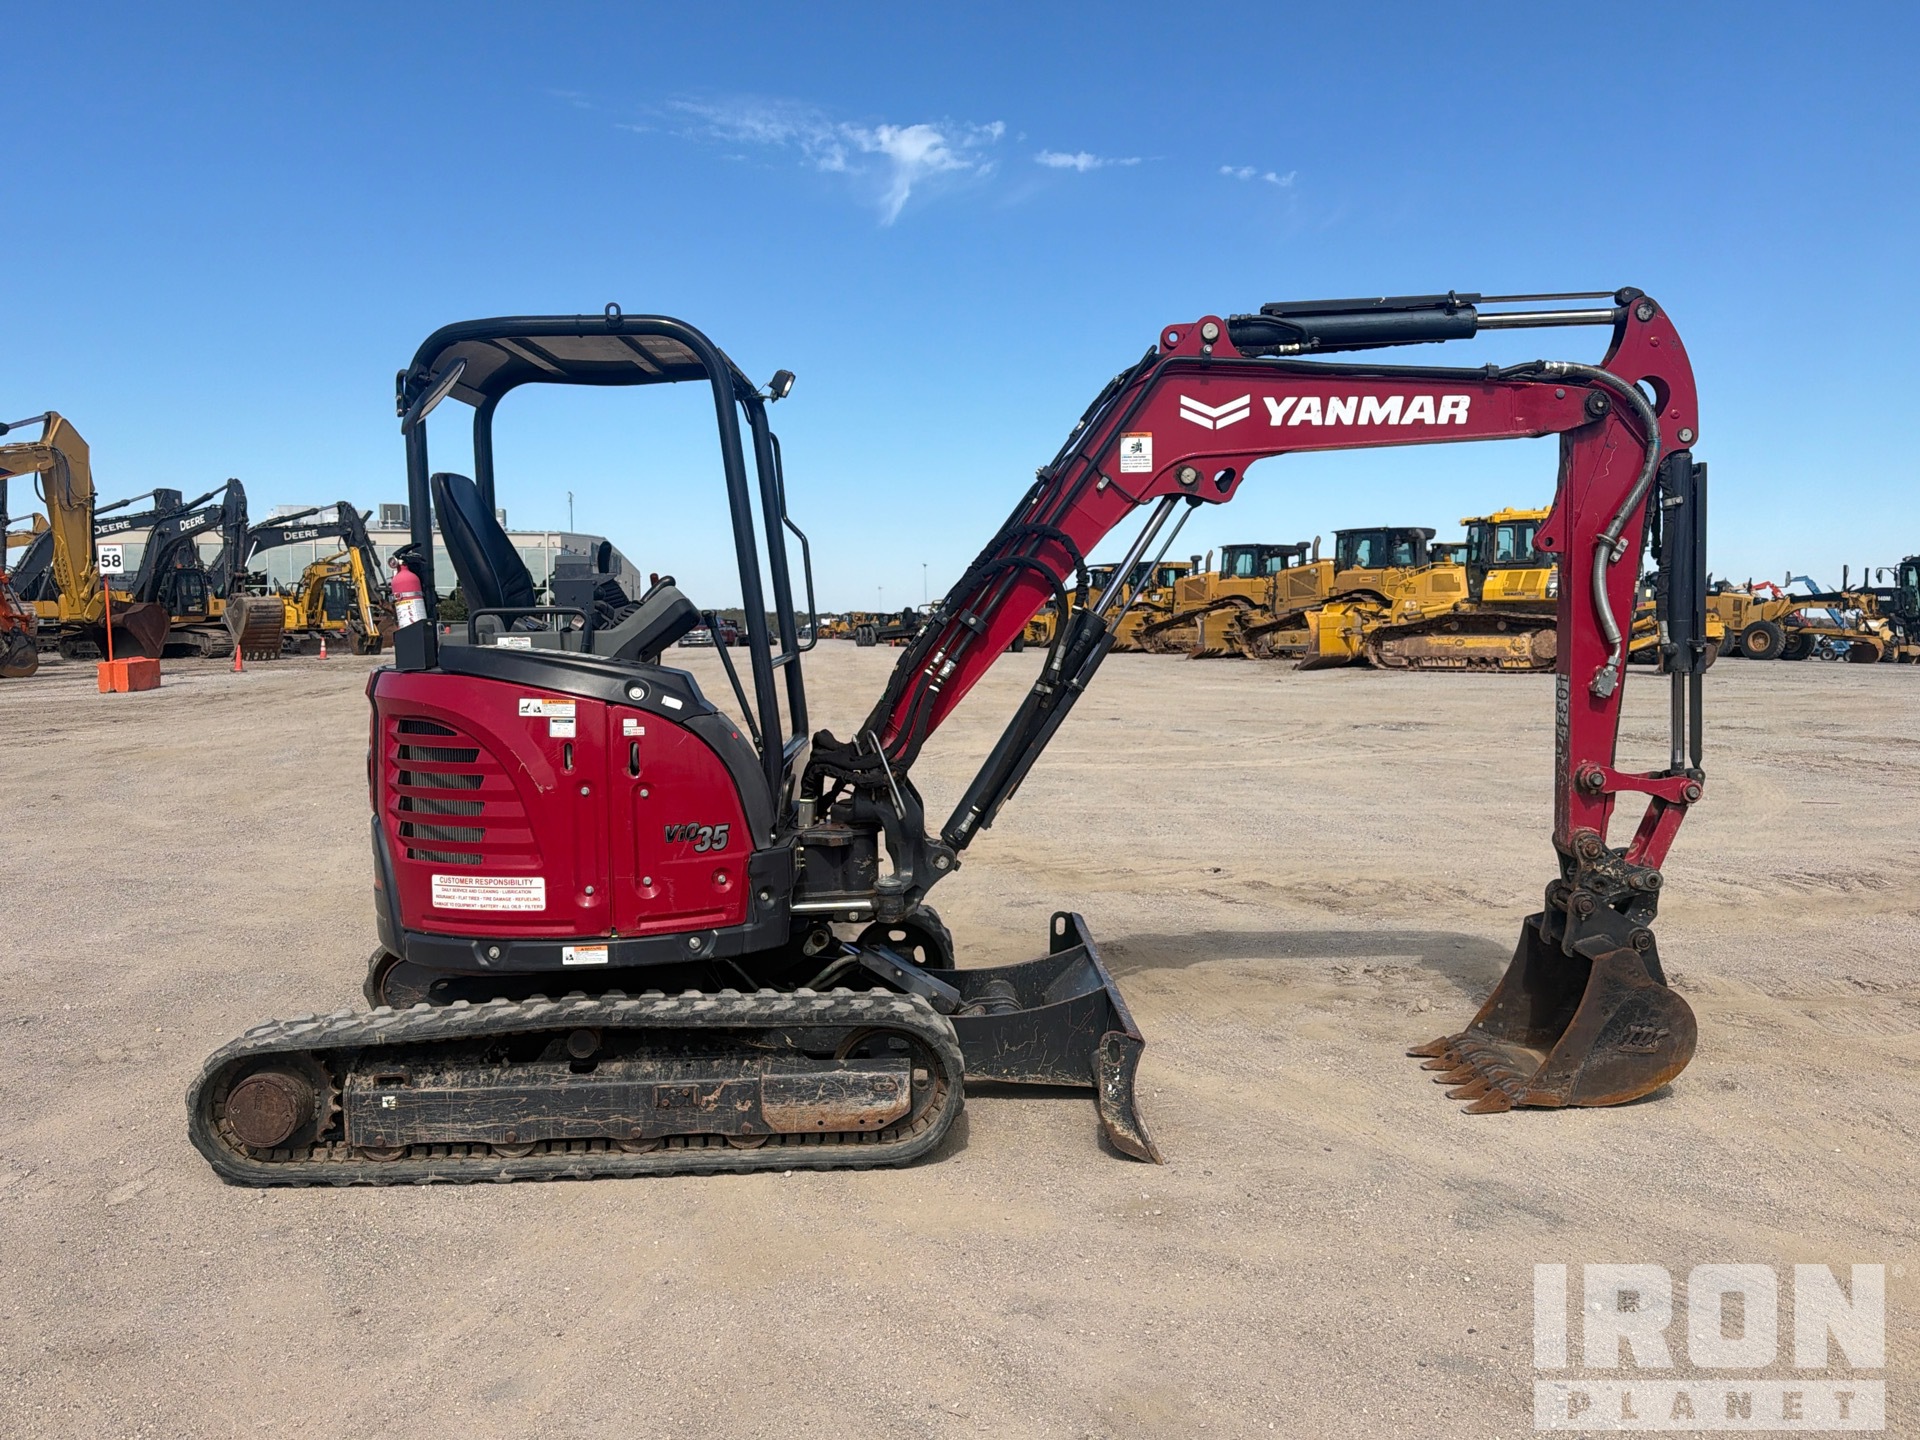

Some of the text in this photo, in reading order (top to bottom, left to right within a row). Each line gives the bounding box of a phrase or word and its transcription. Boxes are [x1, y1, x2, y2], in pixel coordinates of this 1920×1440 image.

[1263, 395, 1471, 426] YANMAR
[94, 520, 132, 535] DEERE
[180, 514, 206, 531] DEERE
[283, 529, 319, 541] DEERE
[101, 554, 122, 568] 58
[1549, 589, 1558, 598] 7
[439, 876, 533, 886] CUSTOMER RESPONSIBILITY
